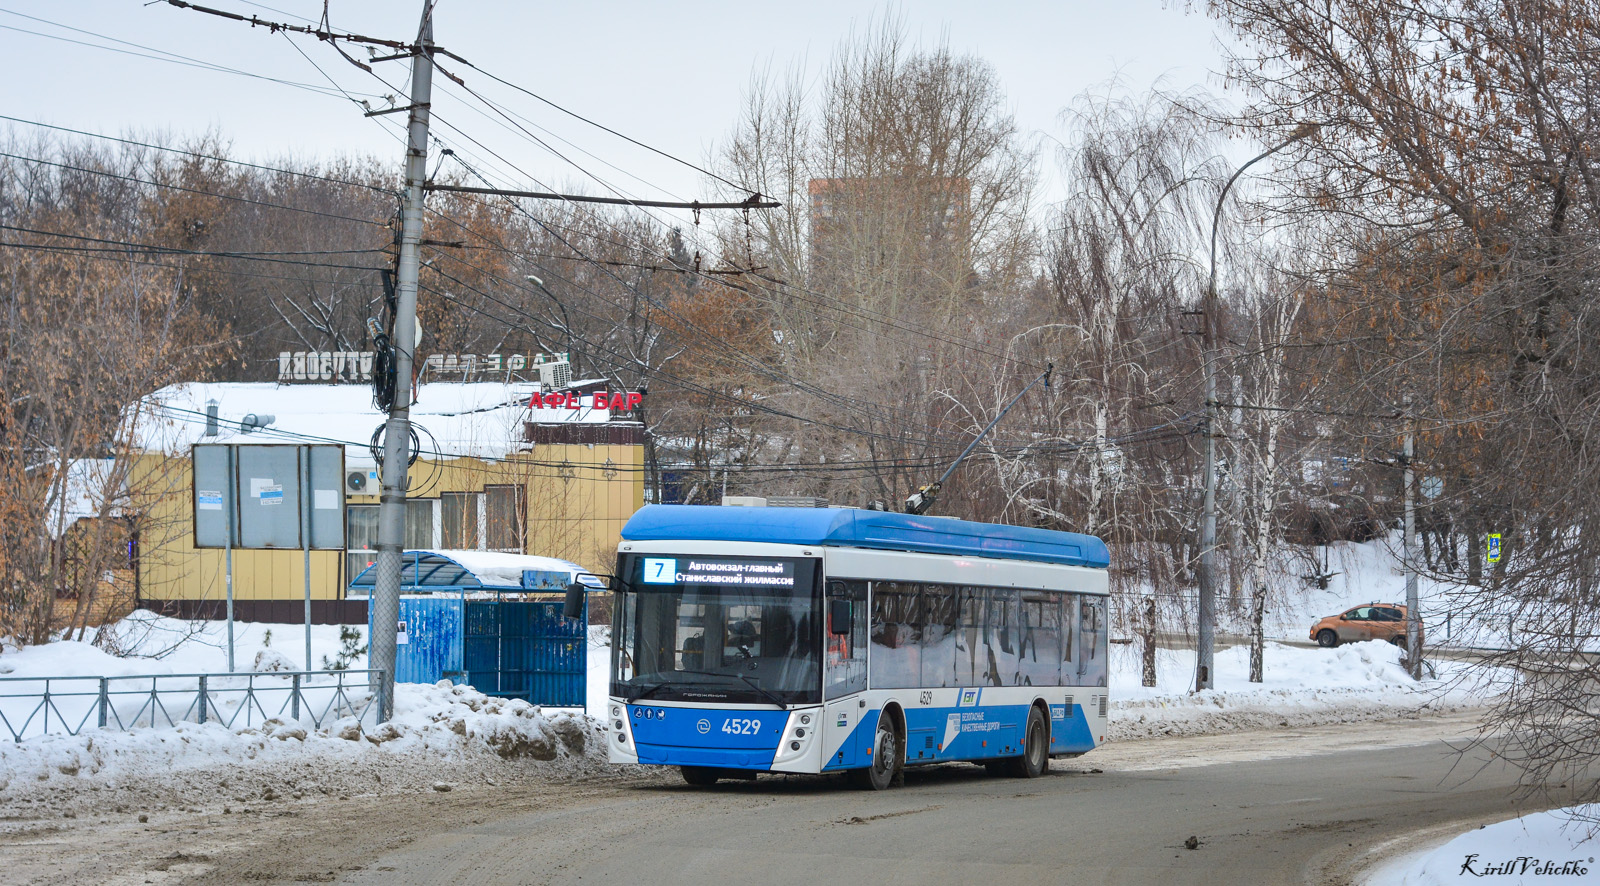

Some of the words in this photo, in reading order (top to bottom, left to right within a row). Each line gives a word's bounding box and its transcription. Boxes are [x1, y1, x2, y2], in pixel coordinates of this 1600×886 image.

[592, 390, 643, 411] БАР
[655, 562, 664, 578] 7
[688, 561, 784, 574] Автовокзал-главный
[675, 573, 742, 584] Станиславский
[919, 690, 933, 706] 4529
[721, 718, 762, 735] 4529
